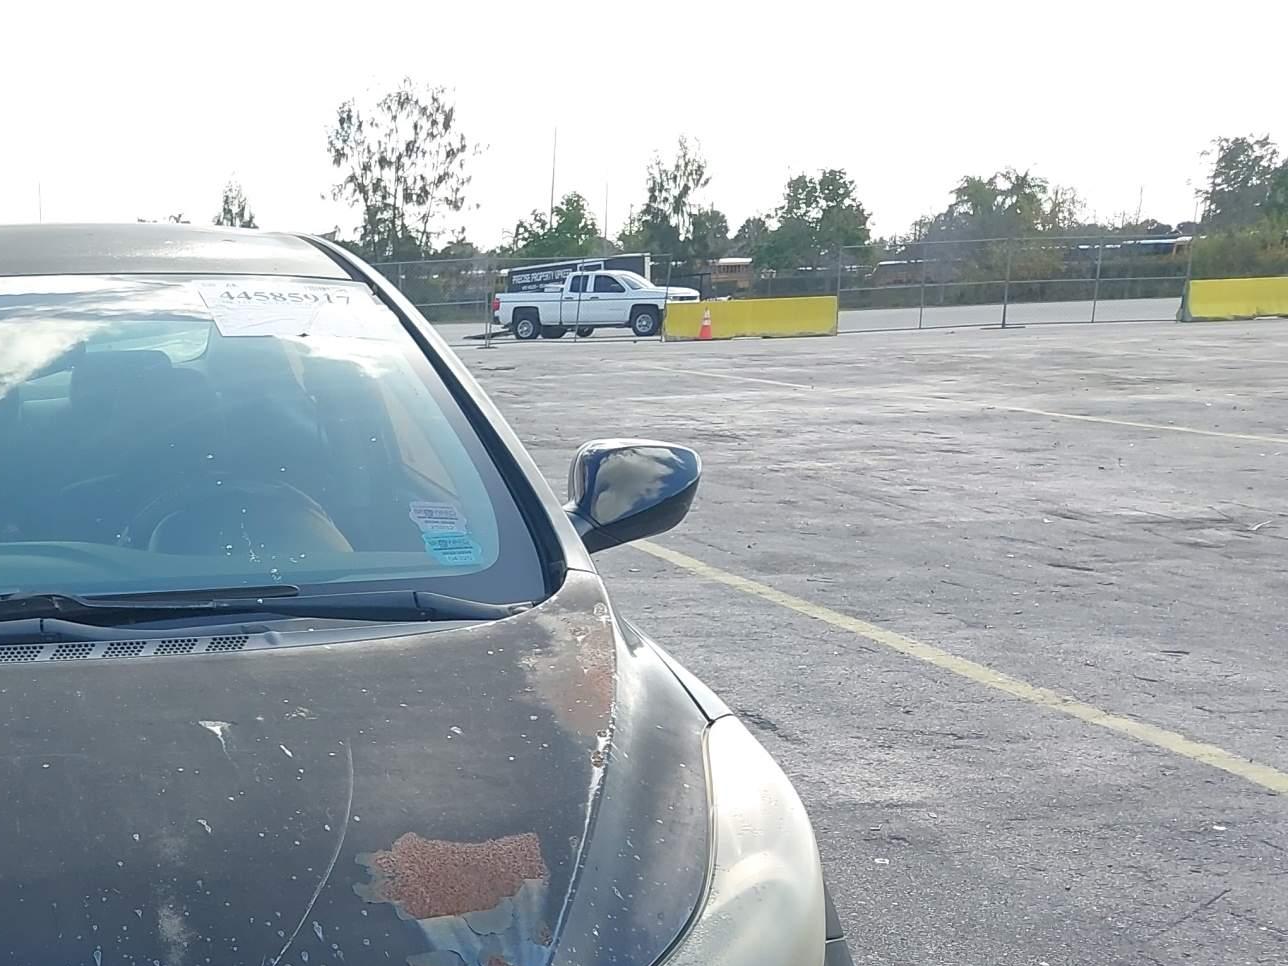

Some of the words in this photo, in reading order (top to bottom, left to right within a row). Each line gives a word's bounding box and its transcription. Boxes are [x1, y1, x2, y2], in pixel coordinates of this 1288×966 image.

[512, 273, 531, 285] PRECISE
[531, 270, 553, 283] PROPERTY
[218, 290, 351, 305] 44585917
